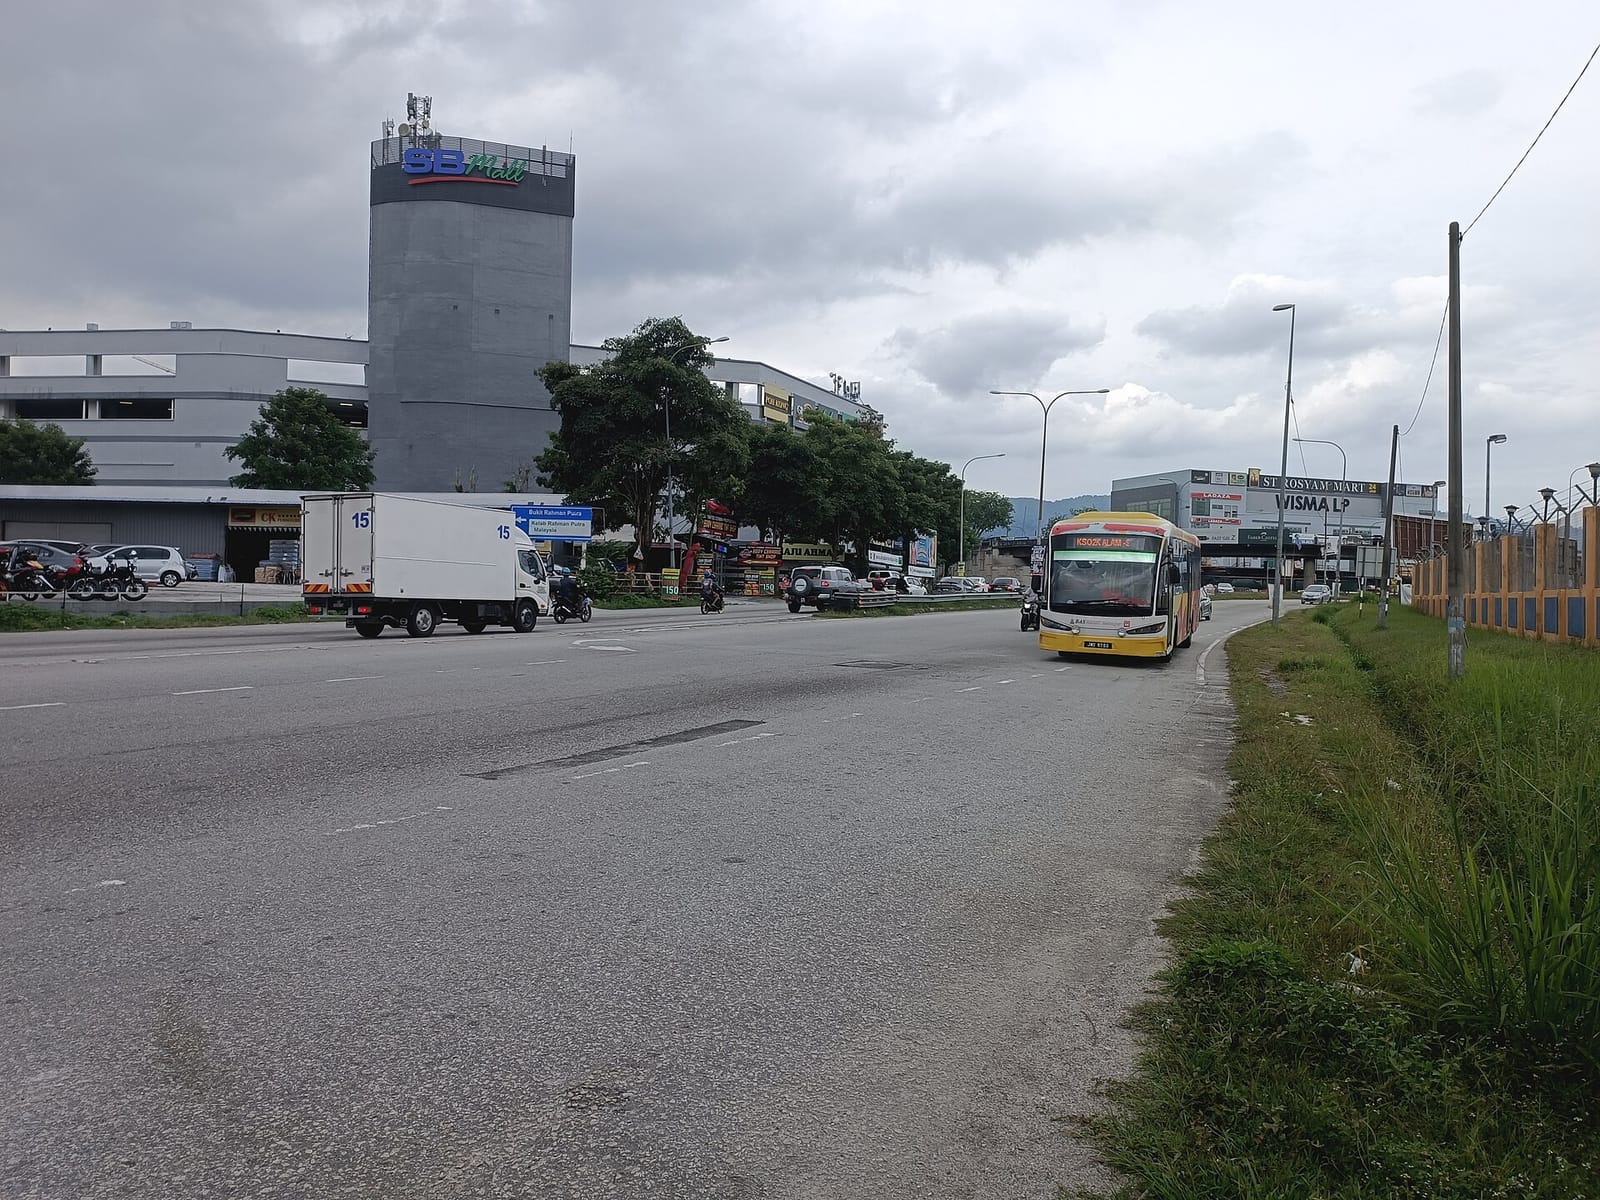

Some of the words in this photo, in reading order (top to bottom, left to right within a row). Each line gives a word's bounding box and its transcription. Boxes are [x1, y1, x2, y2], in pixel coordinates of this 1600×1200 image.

[403, 147, 466, 175] SB
[464, 152, 528, 182] Mall
[1263, 476, 1278, 487] ST
[1333, 481, 1366, 493] MART
[1275, 494, 1330, 512] WISMA
[1333, 497, 1350, 513] LP
[261, 512, 277, 523] CK
[351, 512, 370, 529] 15
[497, 525, 510, 540] 15
[803, 548, 833, 557] AHMA
[665, 586, 679, 595] 150
